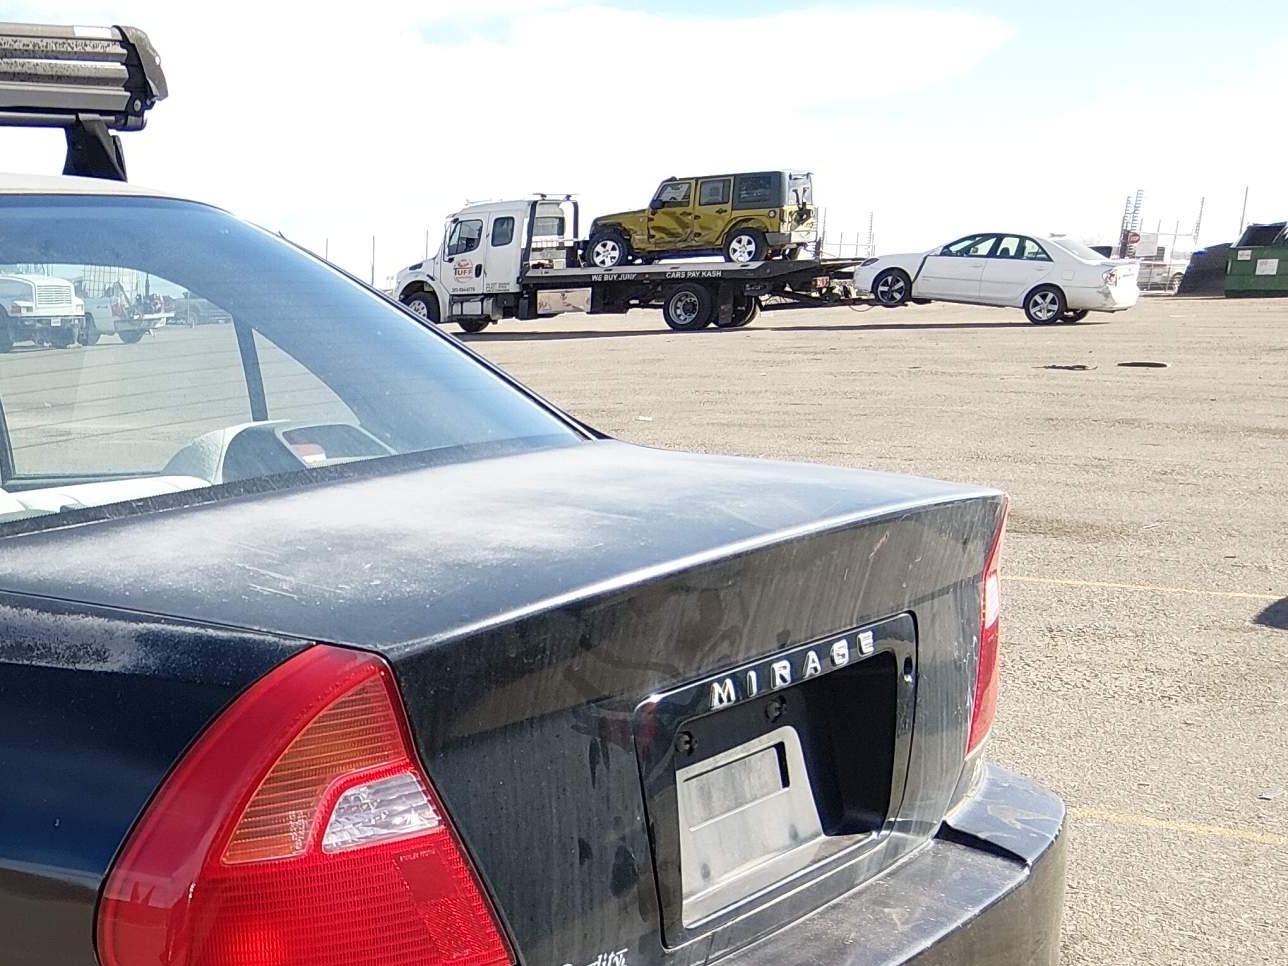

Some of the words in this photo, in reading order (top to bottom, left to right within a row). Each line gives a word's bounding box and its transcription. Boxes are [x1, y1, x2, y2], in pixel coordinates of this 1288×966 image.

[604, 273, 618, 281] BUY
[666, 271, 686, 279] CARS
[687, 271, 701, 279] PAY
[701, 270, 722, 278] KASH
[710, 630, 875, 711] MIRAGE
